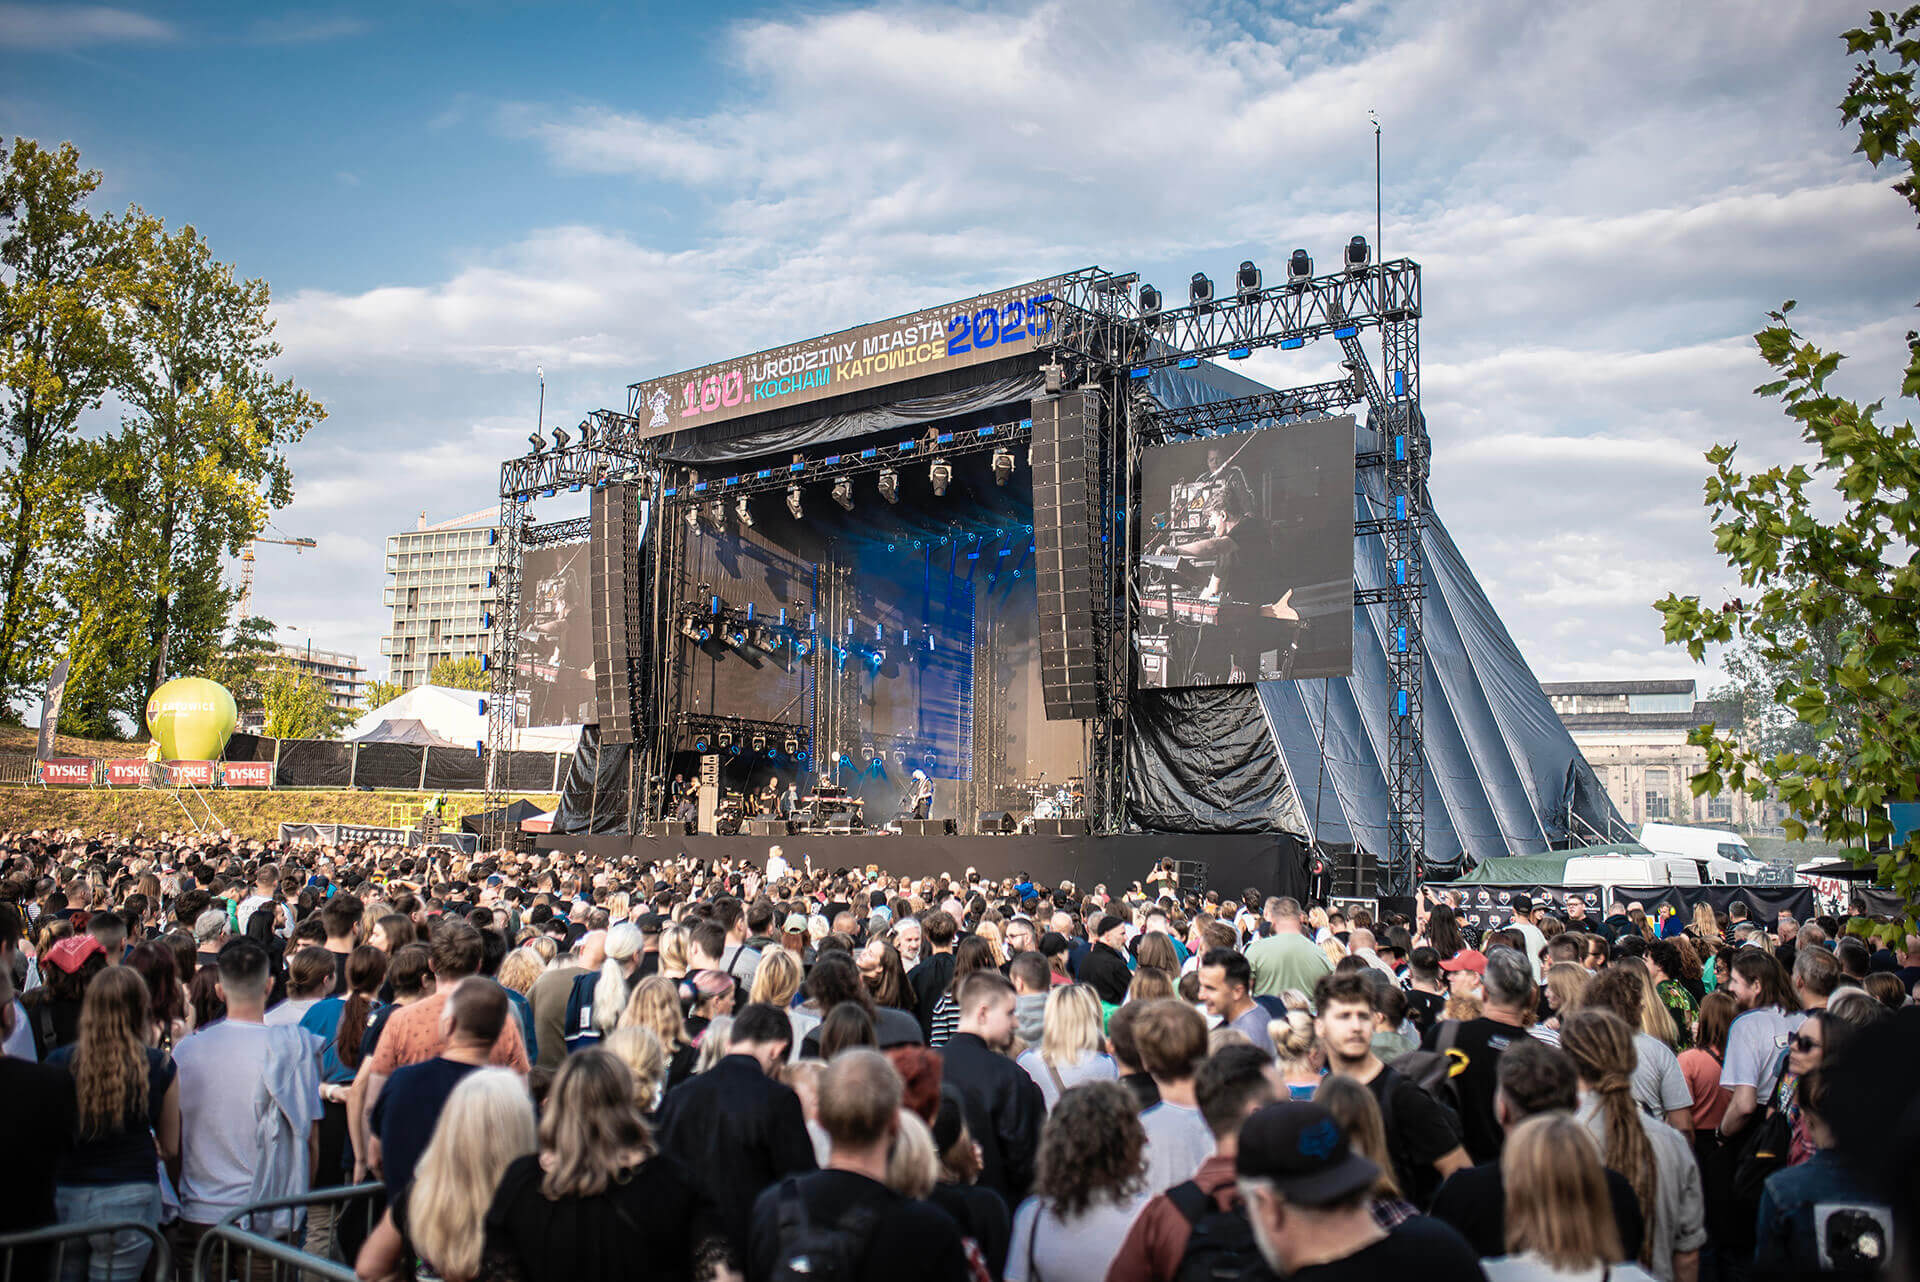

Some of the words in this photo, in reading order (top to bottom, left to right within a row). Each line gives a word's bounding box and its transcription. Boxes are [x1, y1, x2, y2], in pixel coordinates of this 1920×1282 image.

[752, 341, 857, 383] URODZINY
[863, 319, 945, 357] MIASTA
[754, 367, 831, 401] KOCHAM
[836, 340, 945, 382] KATOWICE
[47, 765, 88, 777] TYSKIE
[229, 768, 266, 779] TYSKIE
